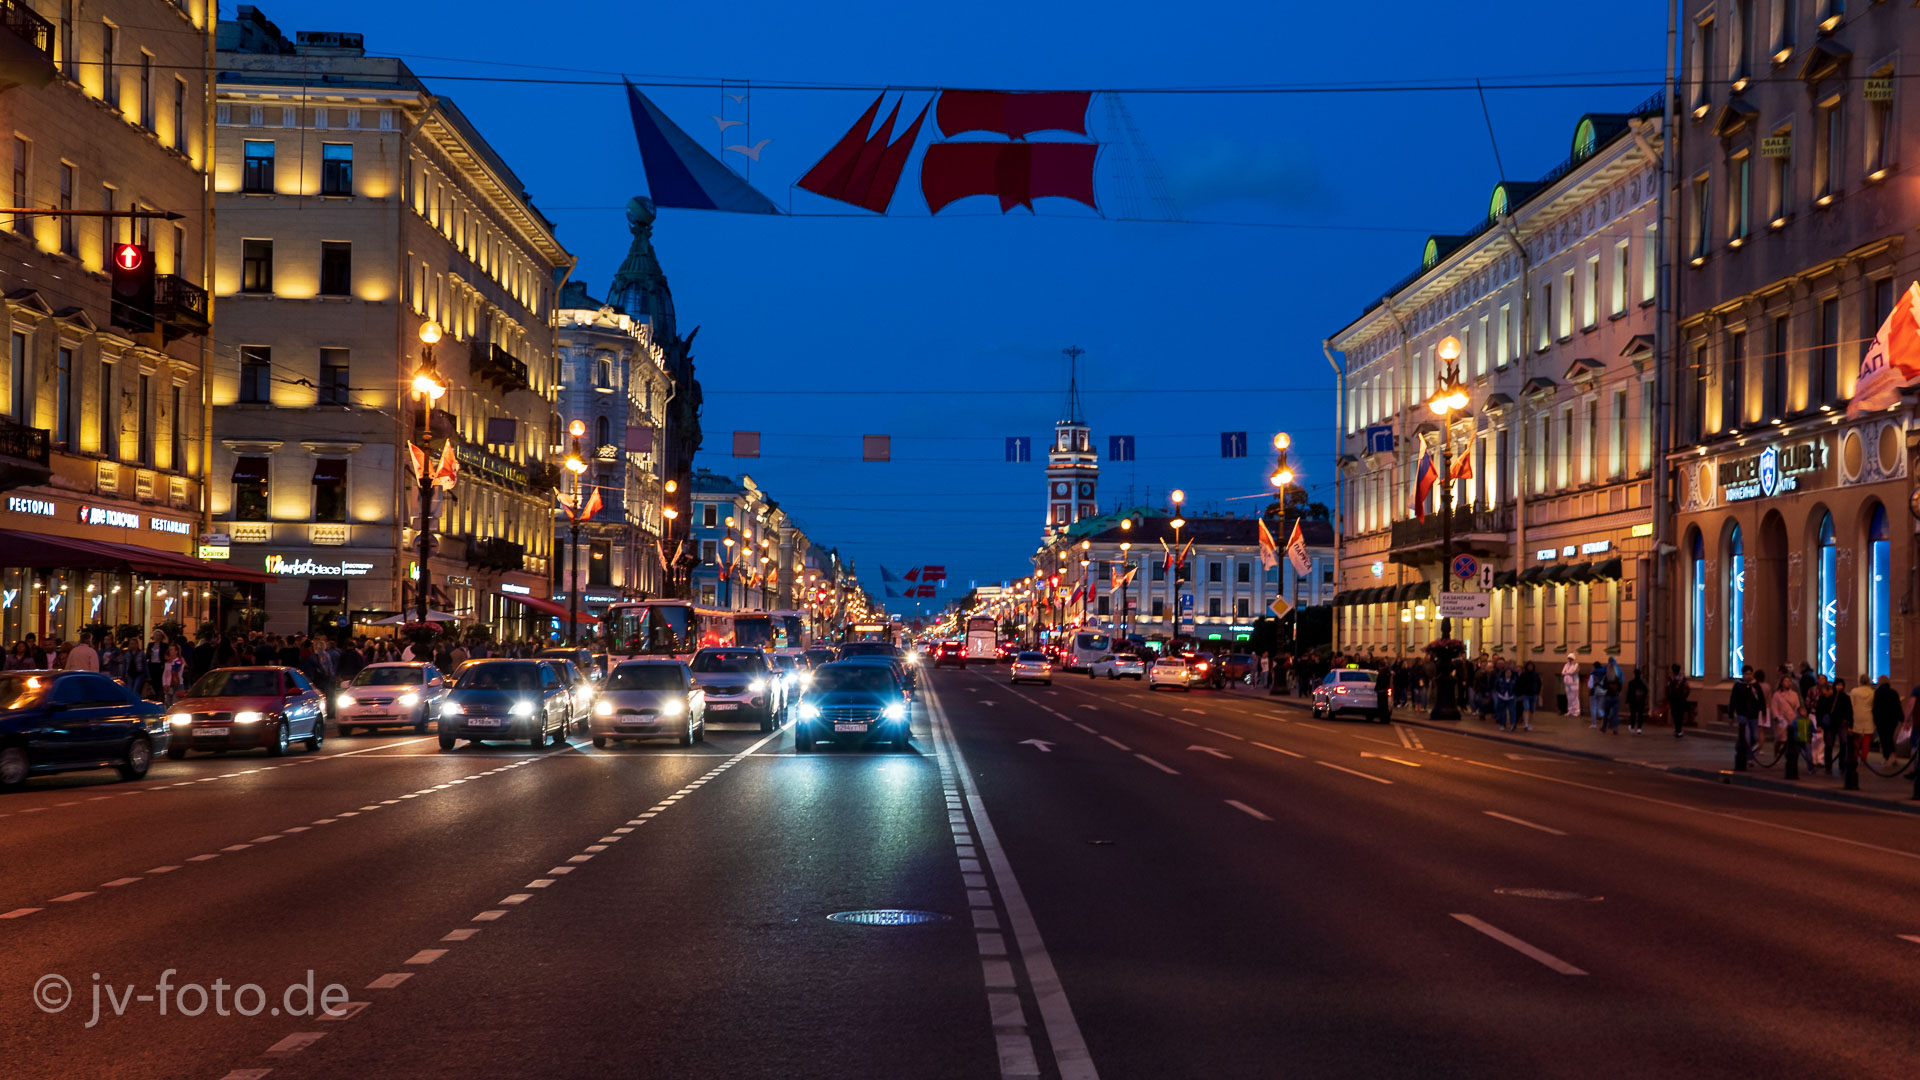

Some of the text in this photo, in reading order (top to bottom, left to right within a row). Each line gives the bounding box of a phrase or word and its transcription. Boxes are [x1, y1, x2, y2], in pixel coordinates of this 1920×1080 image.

[1867, 81, 1893, 89] SALE
[1764, 138, 1789, 147] SALE
[1779, 444, 1811, 472] CLUB
[1779, 476, 1797, 492] КЛУБ
[9, 497, 55, 516] РЕСТОРАН
[151, 517, 190, 535] RESTAURANT
